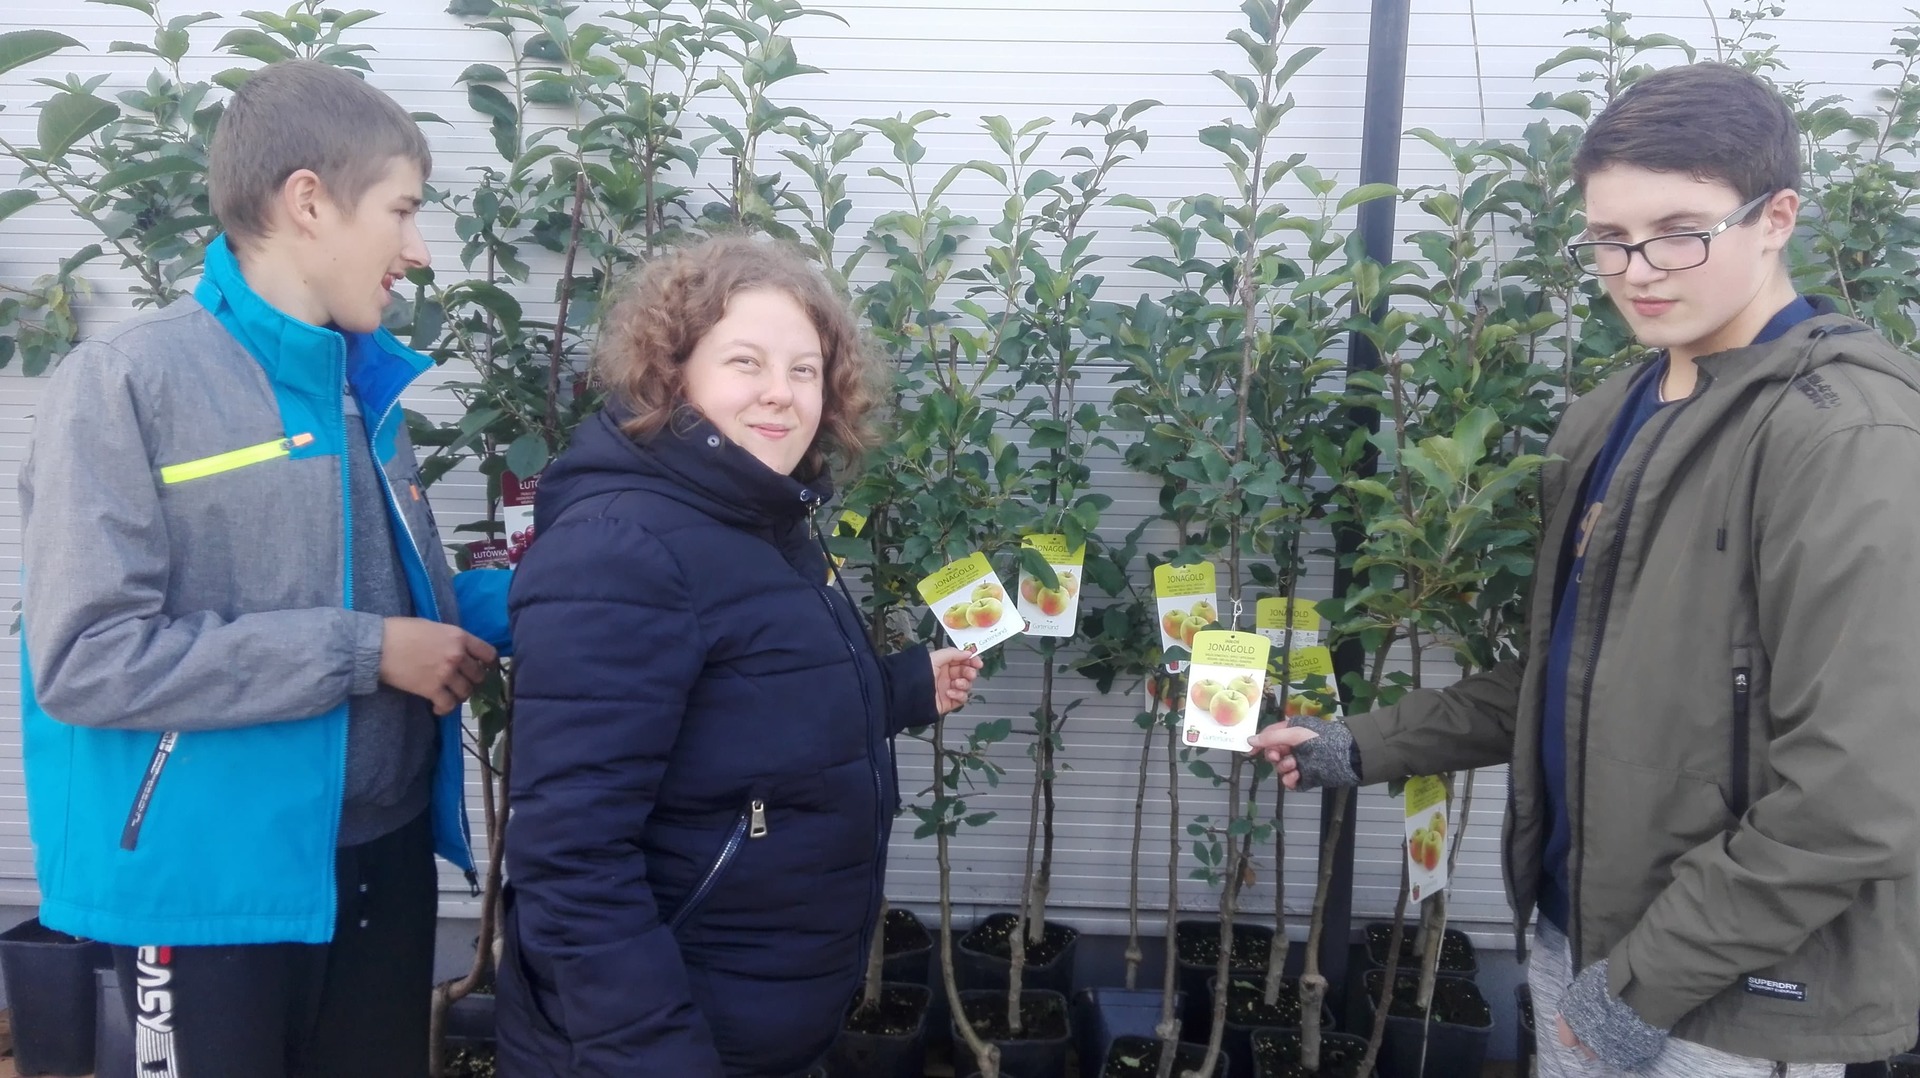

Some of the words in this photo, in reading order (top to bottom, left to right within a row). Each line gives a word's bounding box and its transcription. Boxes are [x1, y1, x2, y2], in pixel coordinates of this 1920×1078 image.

[473, 549, 508, 559] ŁUTÓWKA
[934, 564, 975, 589] JONAGOLD
[1167, 573, 1204, 583] JONAGOLD
[1208, 643, 1255, 654] JONAGOLD
[137, 946, 171, 1033] EASY
[1748, 977, 1797, 990] SUPERDRY
